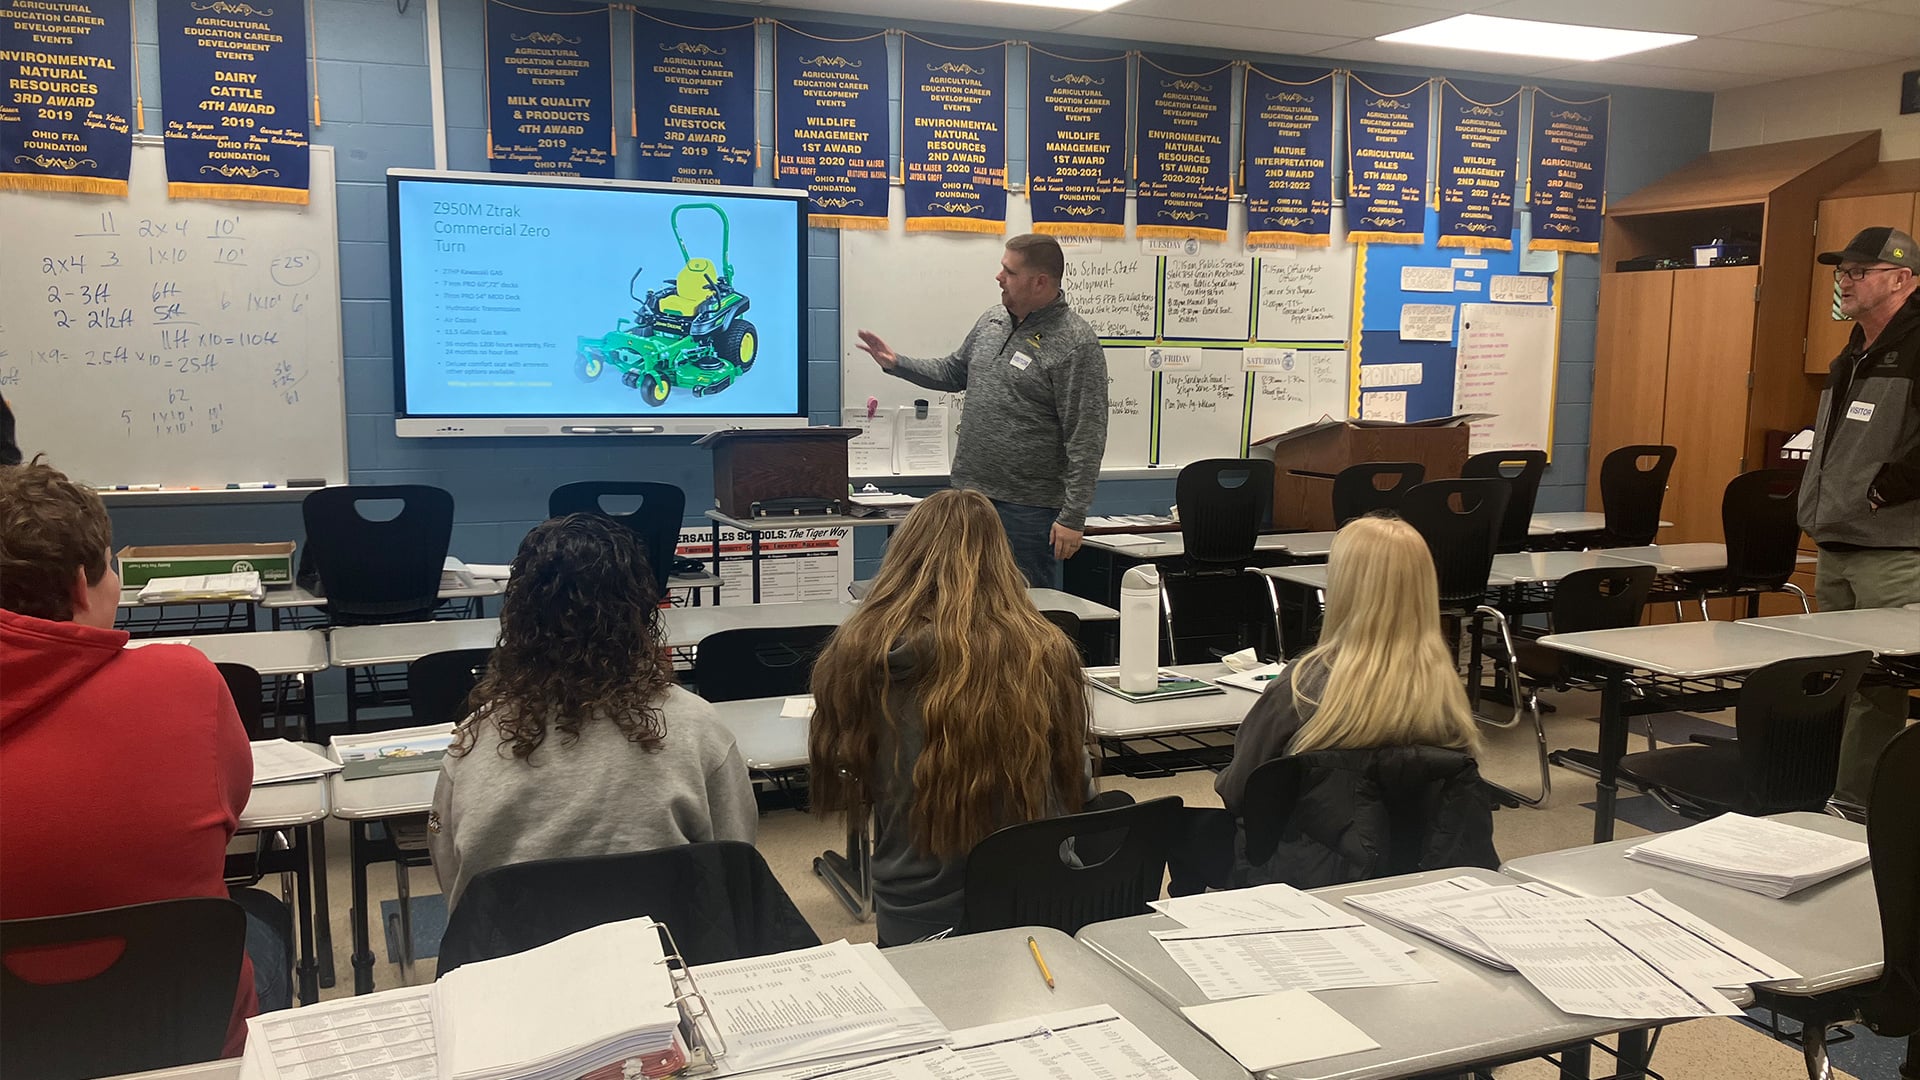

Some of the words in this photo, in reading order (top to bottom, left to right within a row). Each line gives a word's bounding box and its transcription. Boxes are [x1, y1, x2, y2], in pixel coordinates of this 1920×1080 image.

[12, 0, 92, 14] AGRICULTURAL
[64, 15, 104, 26] CAREER
[196, 18, 270, 30] AGRICULTURAL
[14, 22, 91, 35] DEVELOPMENT
[33, 34, 73, 45] EVENTS
[184, 28, 242, 40] EDUCATION
[244, 31, 283, 43] CAREER
[198, 39, 270, 52] DEVELOPMENT
[0, 51, 115, 70] NVIRONMENTAL
[216, 52, 254, 61] EVENTS
[20, 66, 87, 79] NATURAL
[214, 71, 257, 83] DAIRY
[802, 71, 859, 80] AGRICULTURAL
[10, 79, 98, 94] RESOURCES
[793, 80, 837, 88] EDUCATION
[839, 82, 869, 90] CAREER
[211, 86, 263, 99] CATTLE
[803, 90, 858, 98] DEVELOPMENT
[13, 93, 43, 104] 3RD
[47, 95, 95, 108] AWARD
[507, 97, 536, 106] MILK
[541, 97, 591, 108] QUALITY
[199, 101, 226, 111] 4TH
[229, 102, 276, 114] AWARD
[669, 105, 720, 116] GENERAL
[38, 109, 73, 121] 2019
[513, 111, 523, 119] &
[526, 111, 590, 121] PRODUCTS
[221, 117, 255, 128] 2019
[664, 118, 726, 130] LIVESTOCK
[807, 117, 856, 127] WILDLIFE
[915, 118, 998, 131] ENVIRONMENTAL
[518, 125, 540, 134] 4TH
[544, 125, 584, 135] AWARD
[795, 129, 869, 141] MANAGEMENT
[32, 130, 58, 140] OHIO
[61, 132, 79, 141] FFA
[664, 132, 685, 141] 3RD
[688, 133, 726, 143] AWARD
[934, 131, 979, 141] NATURAL
[1057, 131, 1100, 140] WILDLIFE
[1148, 131, 1221, 144] ENVIRONMENTAL
[24, 141, 88, 152] FOUNDATION
[217, 140, 242, 150] OHIO
[244, 142, 261, 151] FFA
[538, 139, 567, 148] 2019
[927, 141, 986, 152] RESOURCES
[1047, 143, 1110, 153] MANAGEMENT
[1165, 143, 1205, 153] NATURAL
[681, 146, 708, 156] 2019
[802, 144, 821, 152] 1ST
[824, 144, 862, 154] AWARD
[1274, 146, 1306, 155] NATURE
[209, 151, 270, 162] FOUNDATION
[928, 153, 949, 161] 2ND
[952, 154, 985, 163] AWARD
[1158, 153, 1211, 164] RESOURCES
[1357, 149, 1415, 160] AGRICULTURAL
[797, 157, 815, 165] KAISER
[819, 157, 845, 165] 2020
[849, 159, 865, 167] CALEB
[867, 159, 885, 168] KAISER
[1053, 156, 1070, 164] 1ST
[1072, 156, 1105, 165] AWARD
[1255, 158, 1324, 168] INTERPRETATION
[1374, 161, 1398, 169] SALES
[1463, 156, 1496, 165] WILDLIFE
[1541, 158, 1592, 170] AGRICULTURAL
[678, 167, 696, 175] OHIO
[781, 167, 798, 175] JAYDEN
[946, 164, 970, 173] 2020
[1056, 168, 1102, 176] 2020-2021
[1178, 165, 1209, 174] AWARD
[1453, 167, 1505, 177] MANAGEMENT
[1163, 174, 1205, 184] 2020-2021
[1285, 170, 1314, 178] AWARD
[1364, 172, 1379, 180] 5TH
[1380, 173, 1408, 181] AWARD
[1558, 170, 1576, 178] SALES
[672, 176, 720, 185] FOUNDATION
[1269, 181, 1310, 189] 2021-2022
[1476, 179, 1499, 187] AWARD
[1547, 179, 1563, 187] 3RD
[808, 185, 856, 193] FOUNDATION
[935, 191, 980, 199] FOUNDATION
[433, 202, 483, 216] Z950M
[486, 203, 520, 218] Ztrak
[434, 220, 516, 237] Commercial
[520, 223, 550, 238] Zero
[434, 239, 465, 252] Turn
[1150, 241, 1182, 249] TUESDAY
[1246, 357, 1281, 365] SATURDAY
[1363, 368, 1420, 385] POINTS
[1849, 406, 1872, 416] VISITOR
[737, 531, 786, 540] SCOOLS:
[789, 530, 804, 538] The
[806, 530, 826, 540] Tiger
[828, 527, 848, 538] Way
